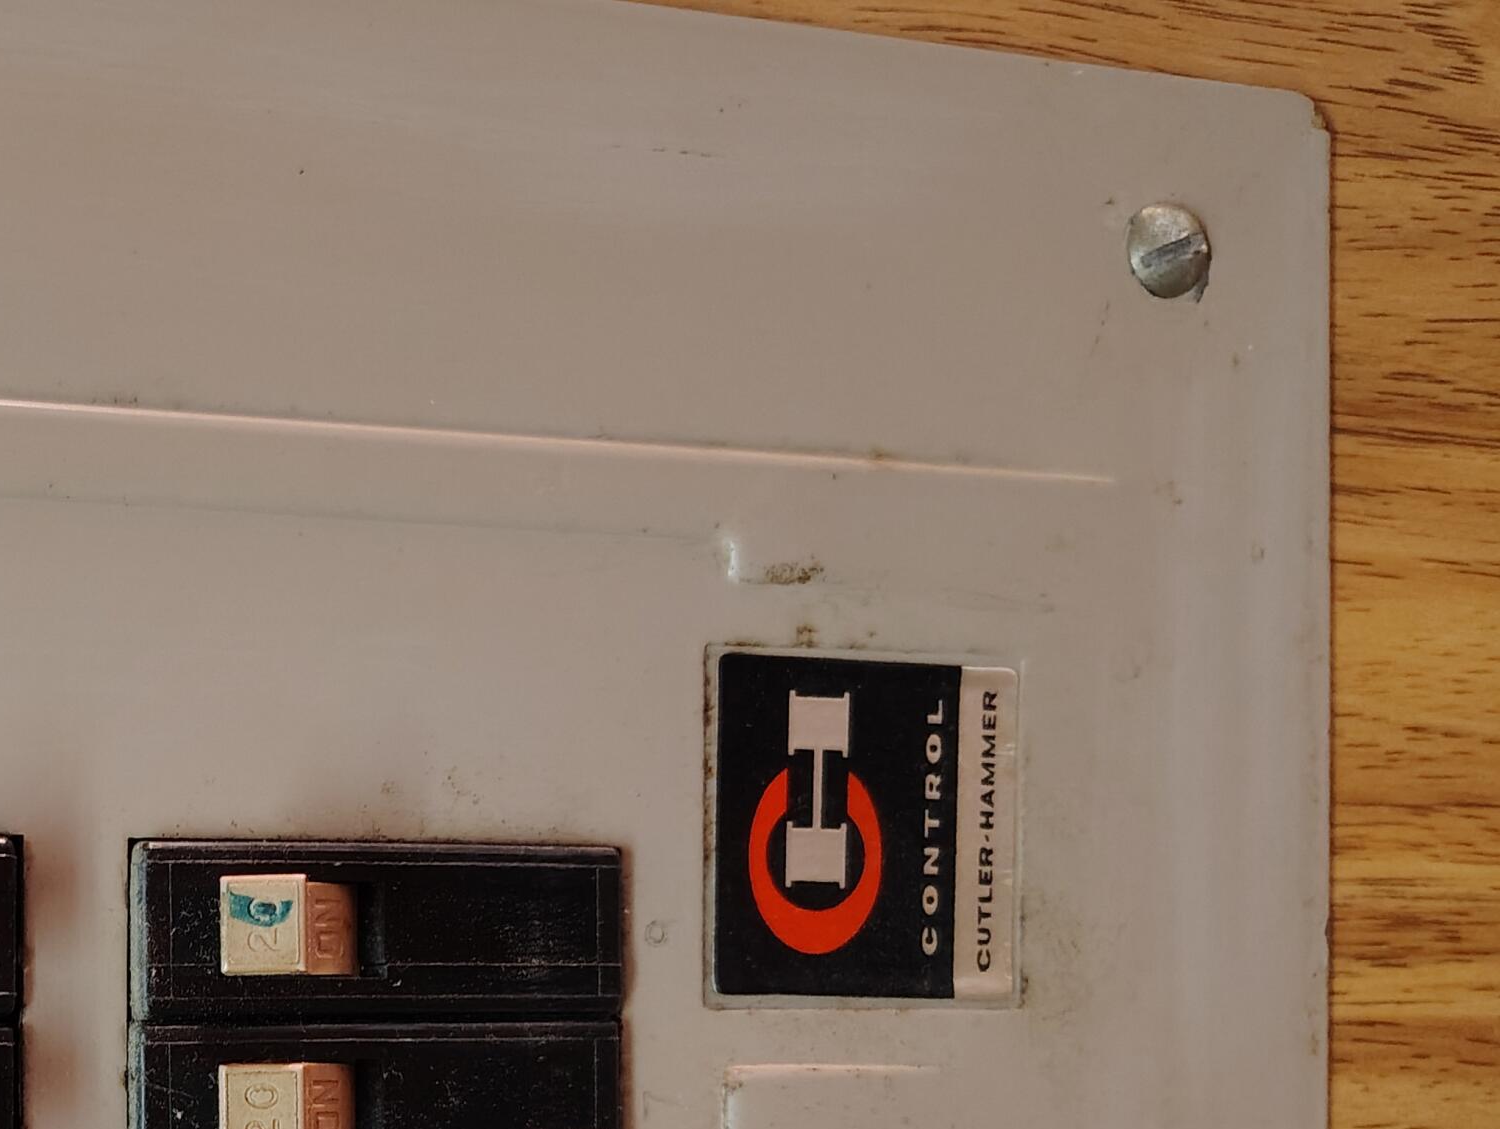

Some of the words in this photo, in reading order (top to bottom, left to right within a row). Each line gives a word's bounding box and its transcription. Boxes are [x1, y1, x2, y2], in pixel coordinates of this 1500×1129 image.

[315, 899, 344, 960] ON
[921, 699, 945, 956] CONTROL
[977, 690, 997, 972] CUTLER-HAMMER
